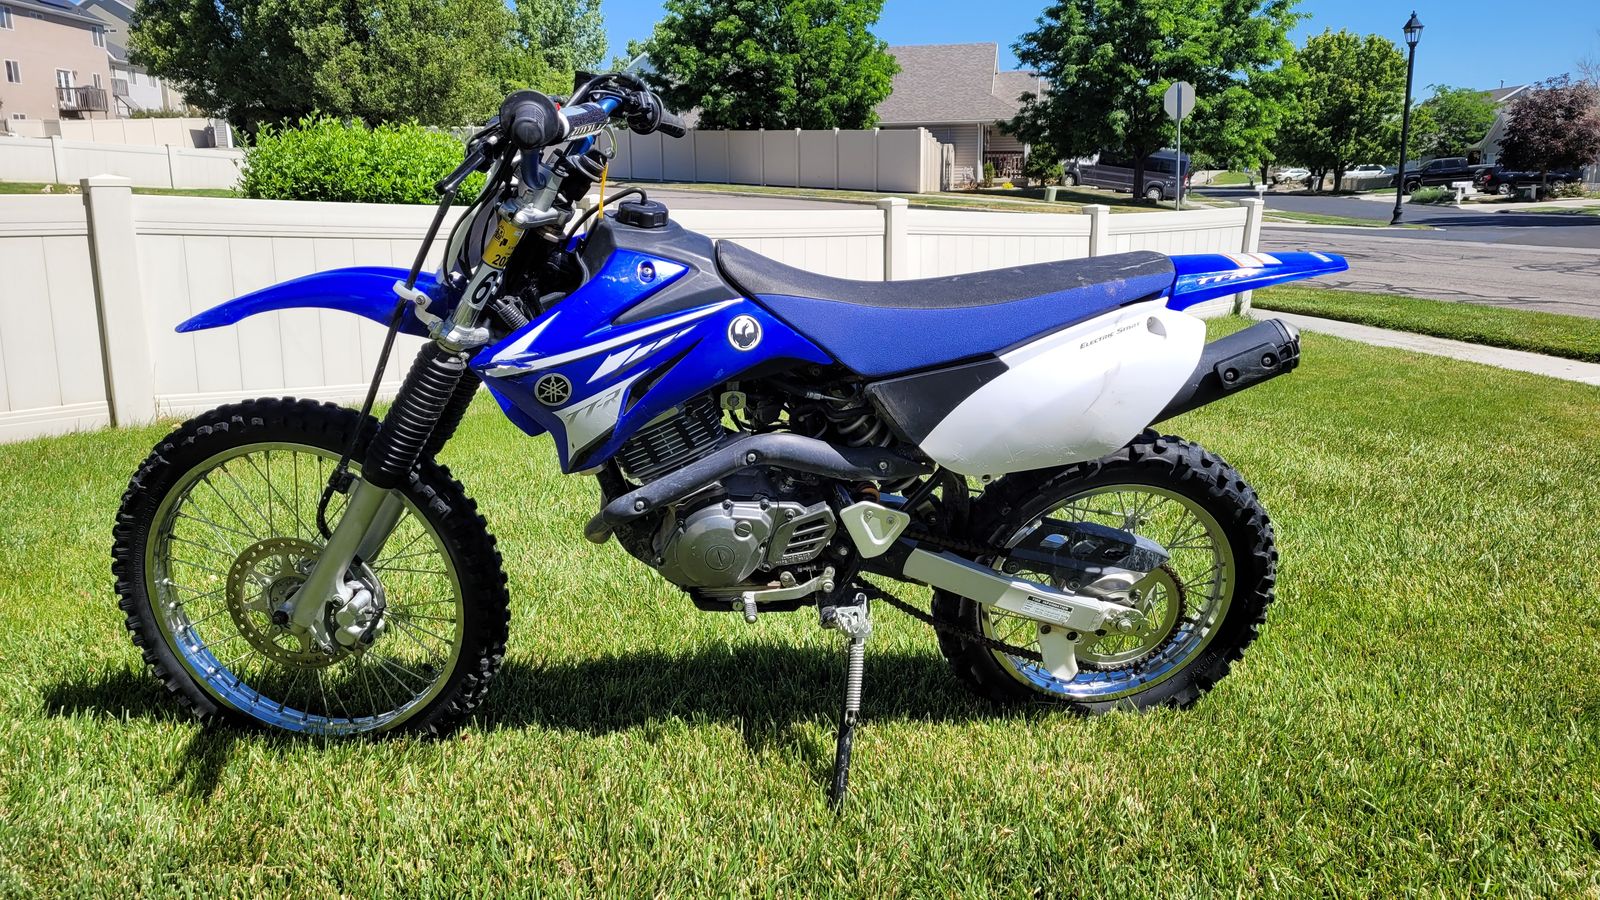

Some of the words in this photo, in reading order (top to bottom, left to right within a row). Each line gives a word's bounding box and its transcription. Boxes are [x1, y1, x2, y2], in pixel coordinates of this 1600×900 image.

[491, 254, 508, 267] 20
[472, 270, 498, 304] 6
[565, 388, 621, 424] TT-R
